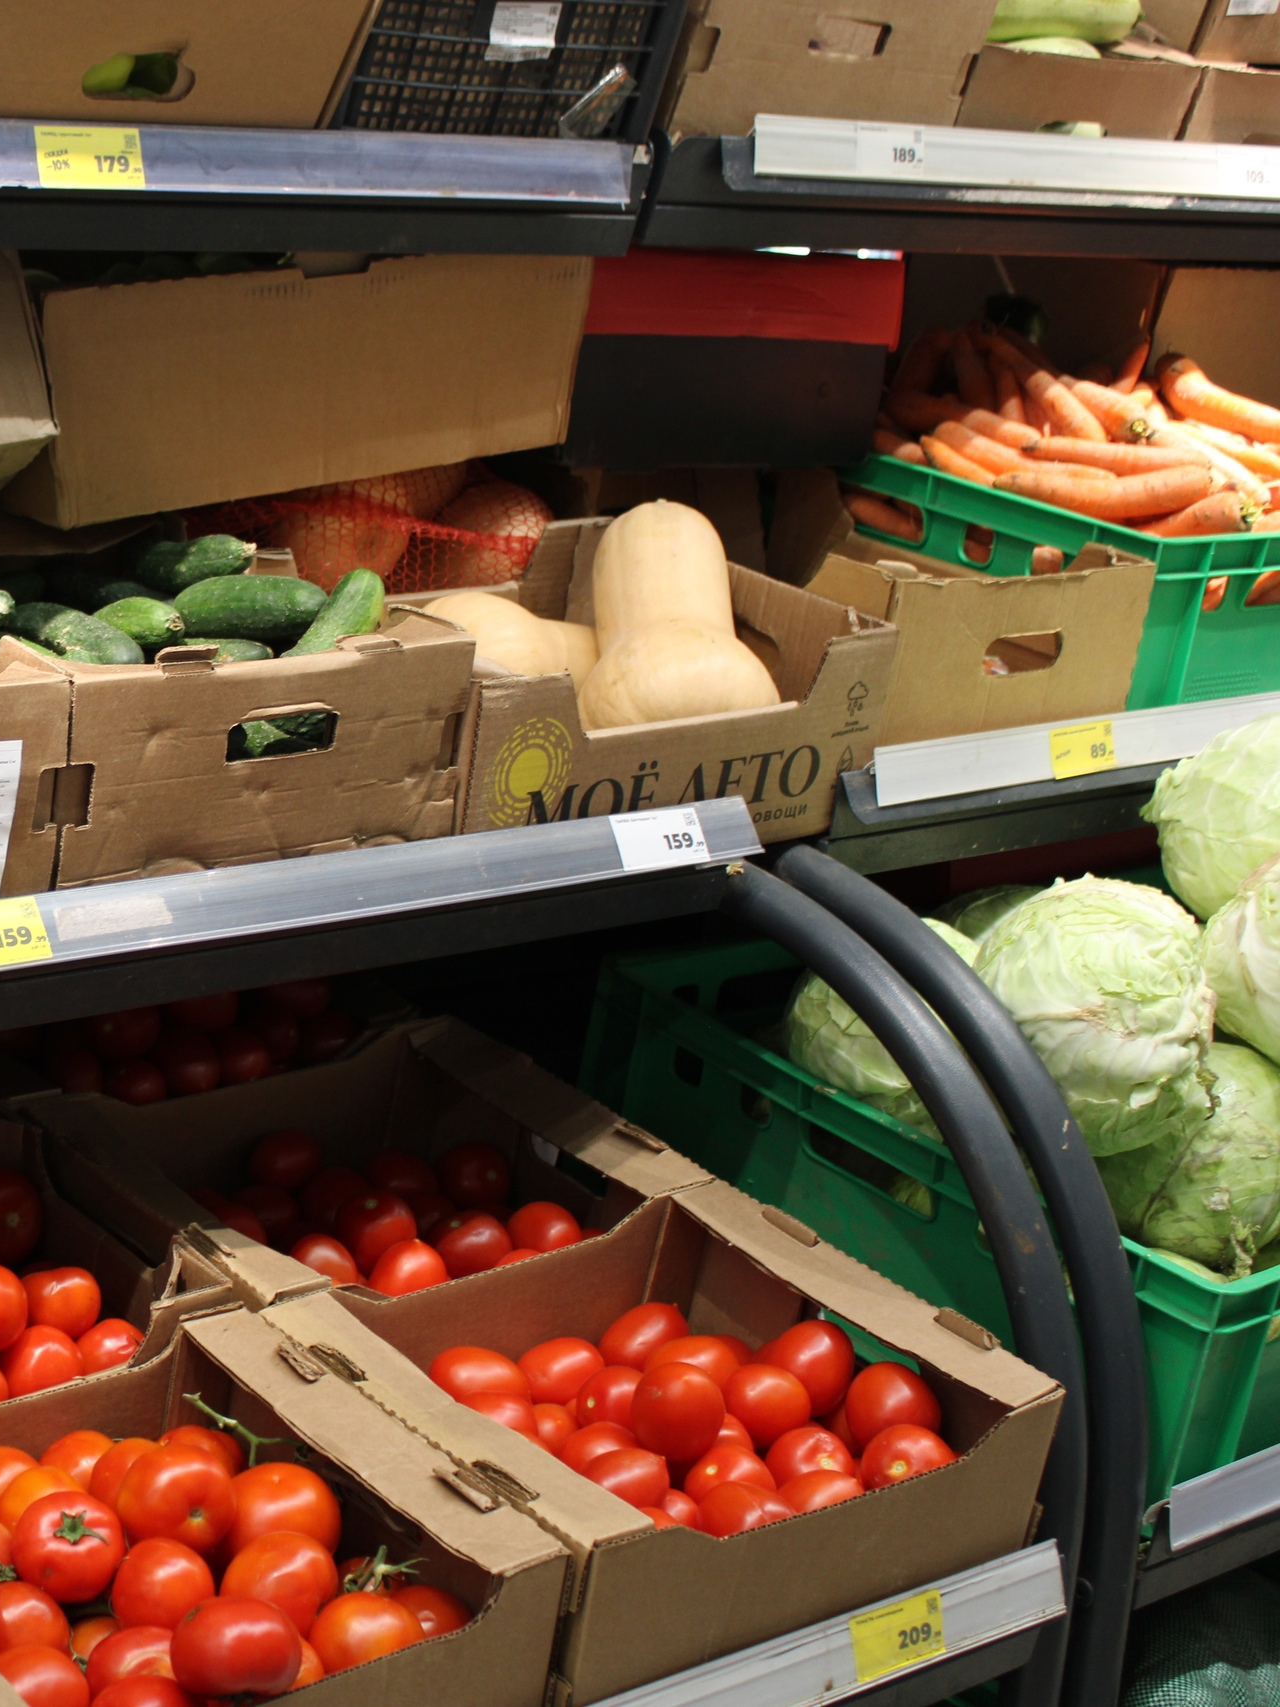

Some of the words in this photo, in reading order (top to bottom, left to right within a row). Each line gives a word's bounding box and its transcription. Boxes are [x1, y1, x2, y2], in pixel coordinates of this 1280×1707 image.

[94, 155, 130, 173] 179
[893, 147, 916, 163] 189
[1091, 742, 1107, 759] 89
[526, 760, 660, 827] МОЁ
[677, 745, 821, 806] ЛЕТО
[753, 804, 807, 823] ОВОЩИ
[663, 832, 694, 850] 159
[898, 1622, 932, 1650] 209
